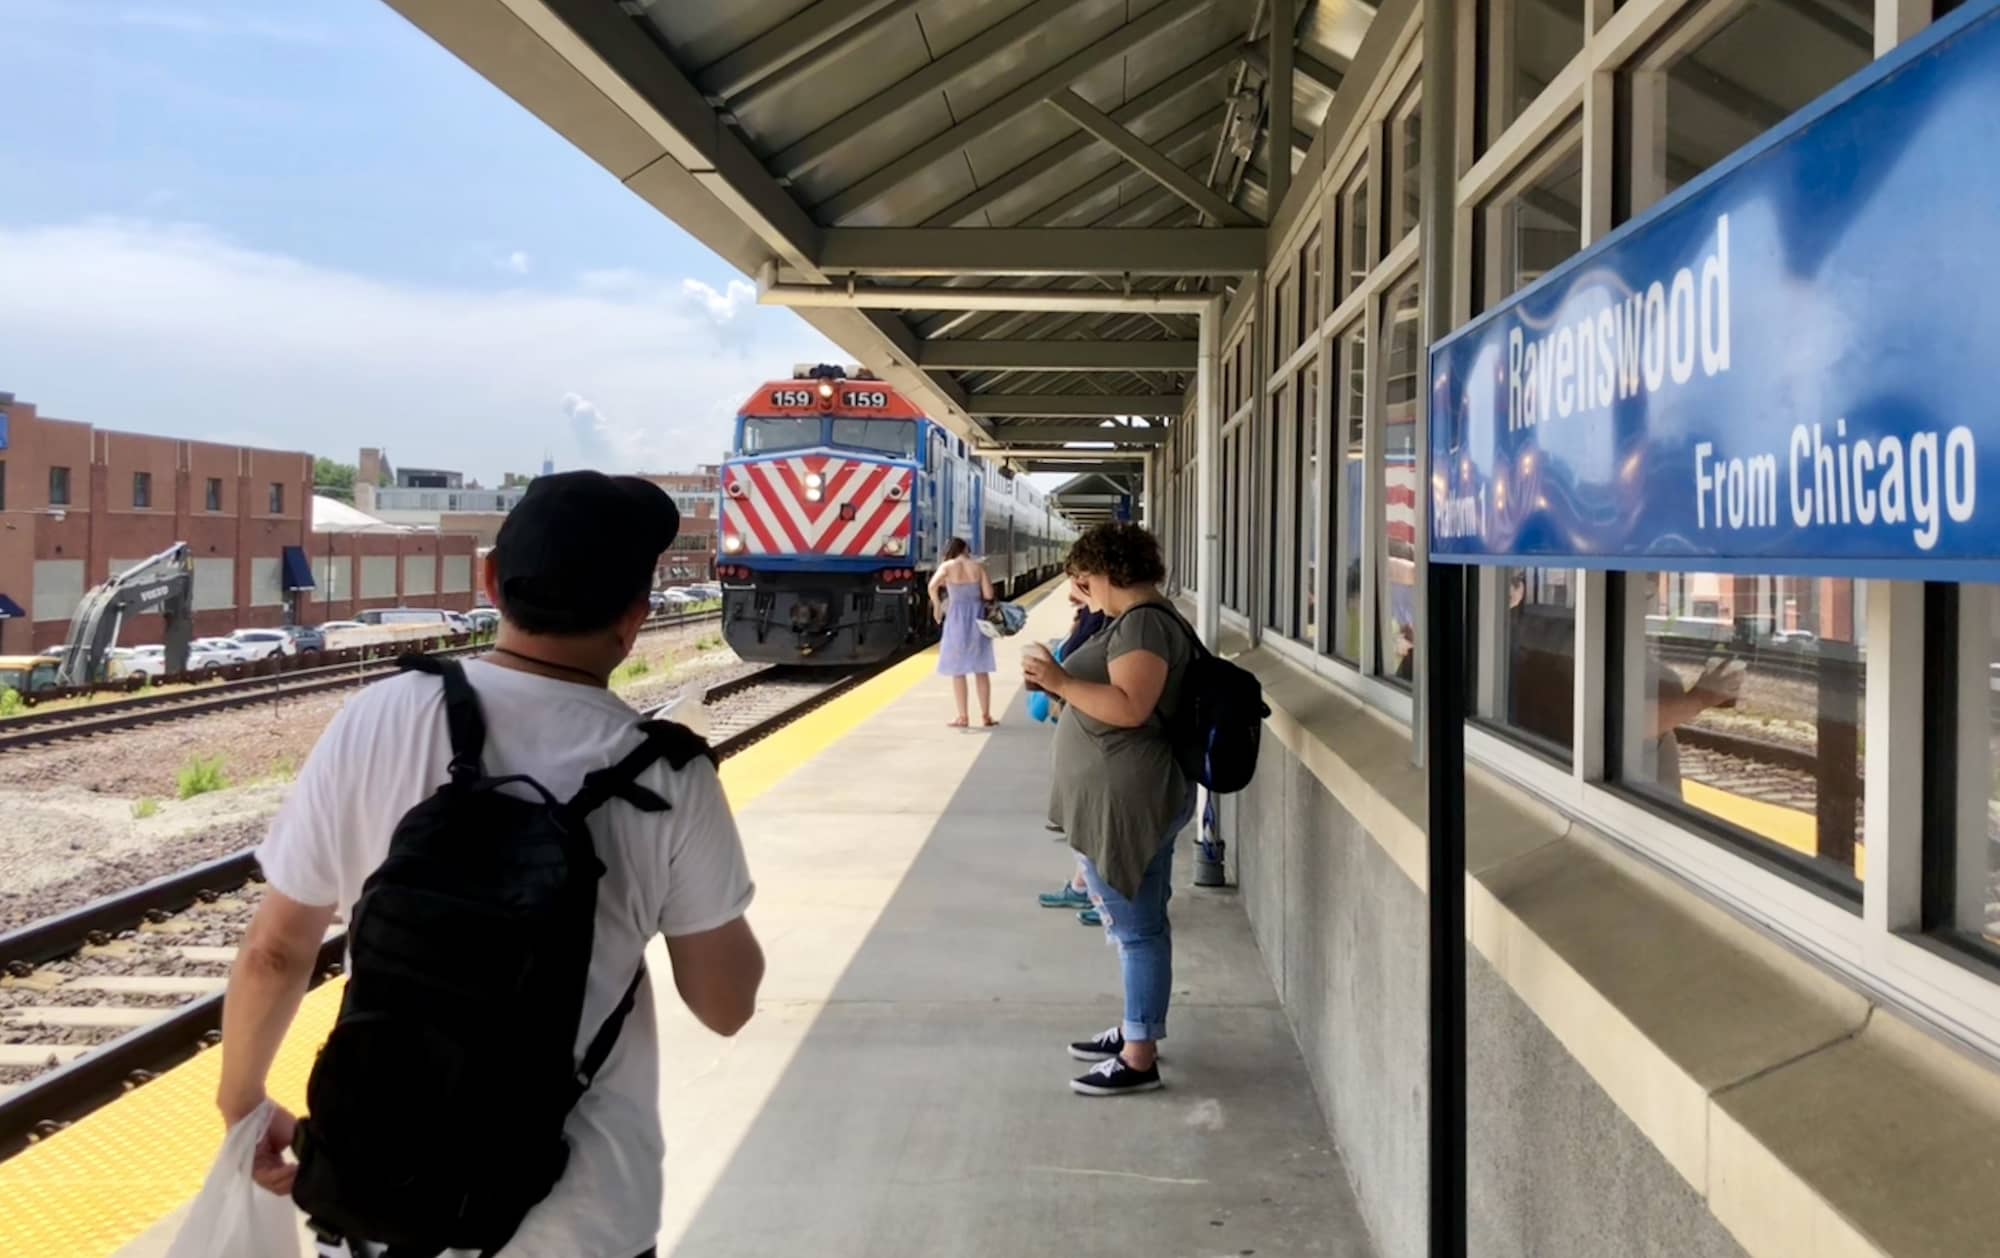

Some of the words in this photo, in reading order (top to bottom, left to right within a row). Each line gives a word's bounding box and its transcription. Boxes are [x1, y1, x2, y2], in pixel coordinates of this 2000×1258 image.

[1509, 213, 1730, 432] Ravenswood
[774, 391, 809, 407] 159
[848, 392, 885, 408] 159
[1695, 441, 1776, 529] From
[1790, 418, 1976, 550] Chicago
